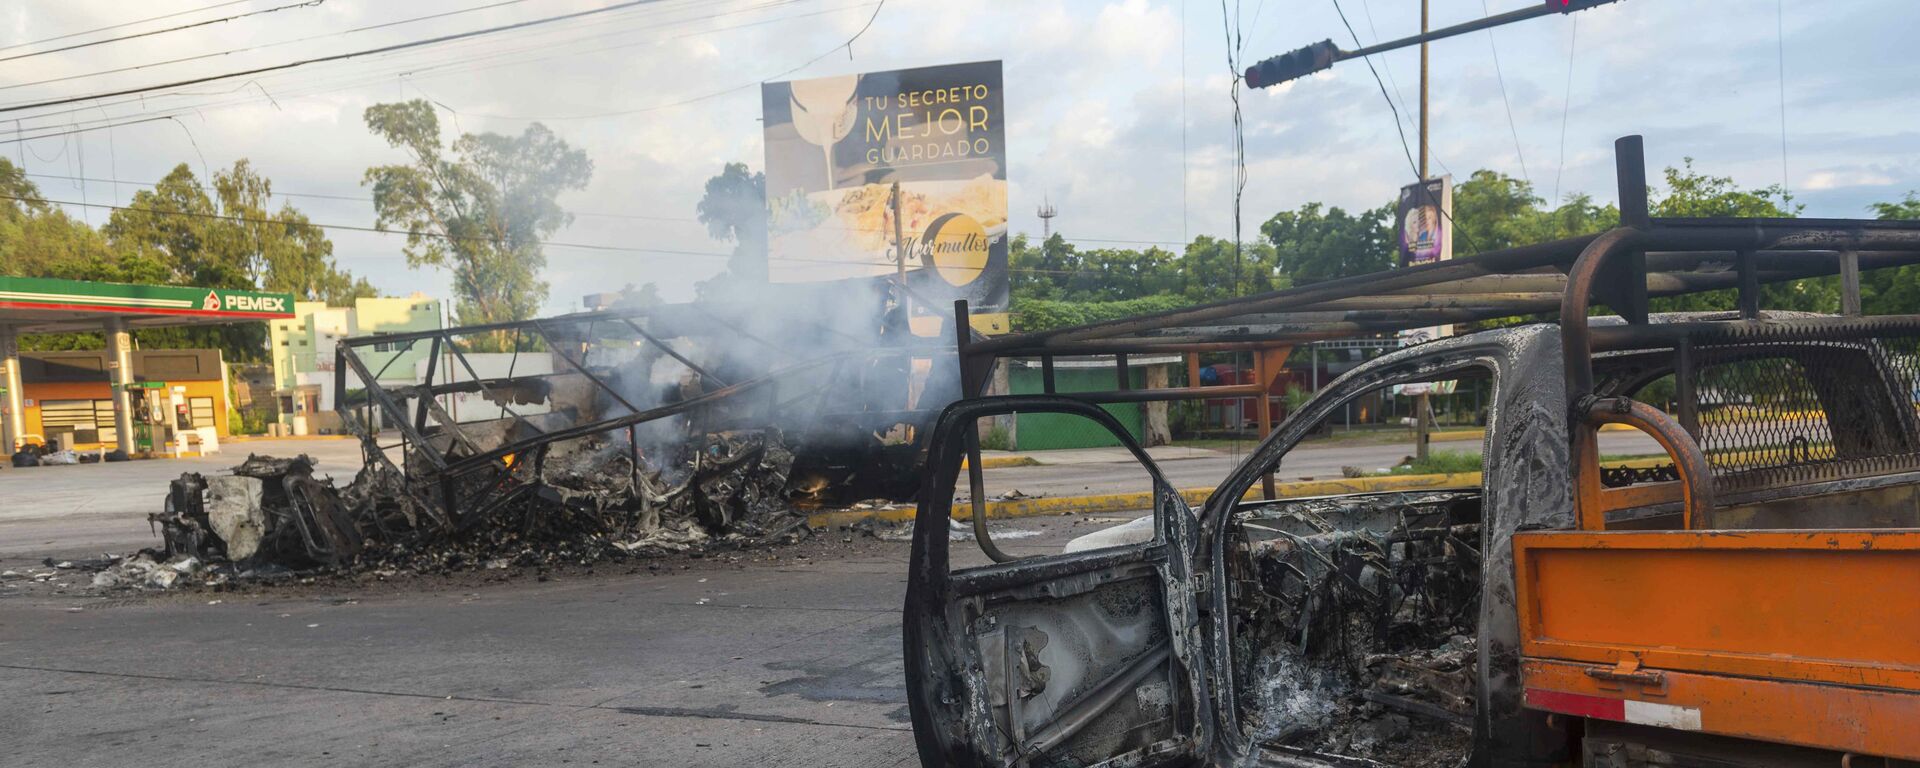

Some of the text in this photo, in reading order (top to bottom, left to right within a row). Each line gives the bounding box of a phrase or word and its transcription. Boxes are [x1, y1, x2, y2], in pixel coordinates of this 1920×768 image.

[866, 84, 988, 111] TU SECRETO
[866, 106, 988, 143] MEJOR
[867, 138, 989, 164] GUARDADO
[225, 294, 285, 312] PEMEX
